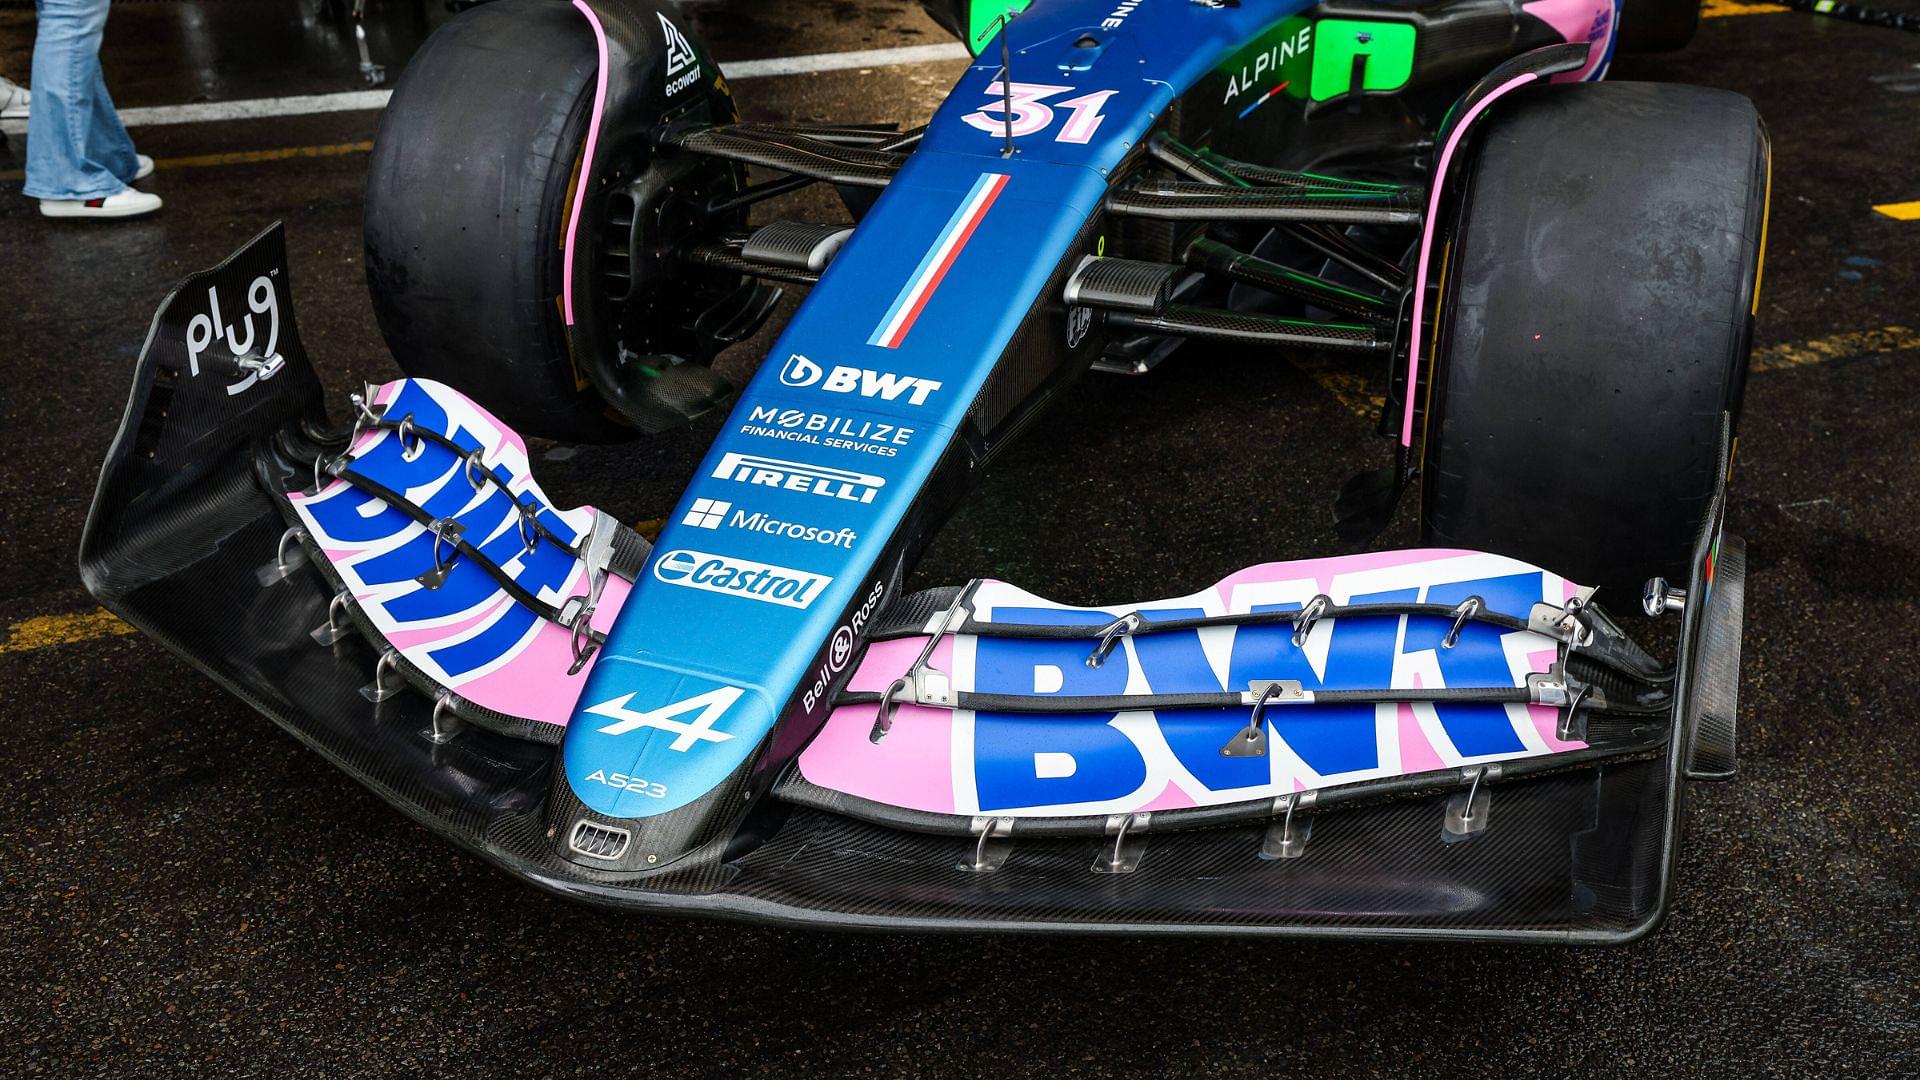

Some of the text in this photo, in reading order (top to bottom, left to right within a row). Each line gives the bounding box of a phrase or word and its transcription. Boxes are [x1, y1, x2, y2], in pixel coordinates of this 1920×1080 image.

[1101, 0, 1143, 28] INE
[665, 64, 701, 97] ecowatt
[1224, 26, 1311, 105] ALPINE
[961, 81, 1120, 144] 31
[821, 365, 943, 406] BWT
[740, 425, 898, 458] FINANCIAL SERVICES
[711, 452, 887, 504] PIRELLI
[729, 509, 857, 549] Microsoft
[691, 559, 817, 603] Castrol
[803, 664, 832, 715] Bell
[851, 580, 884, 635] Ross
[974, 571, 1544, 812] BWT
[584, 769, 668, 799] A523
